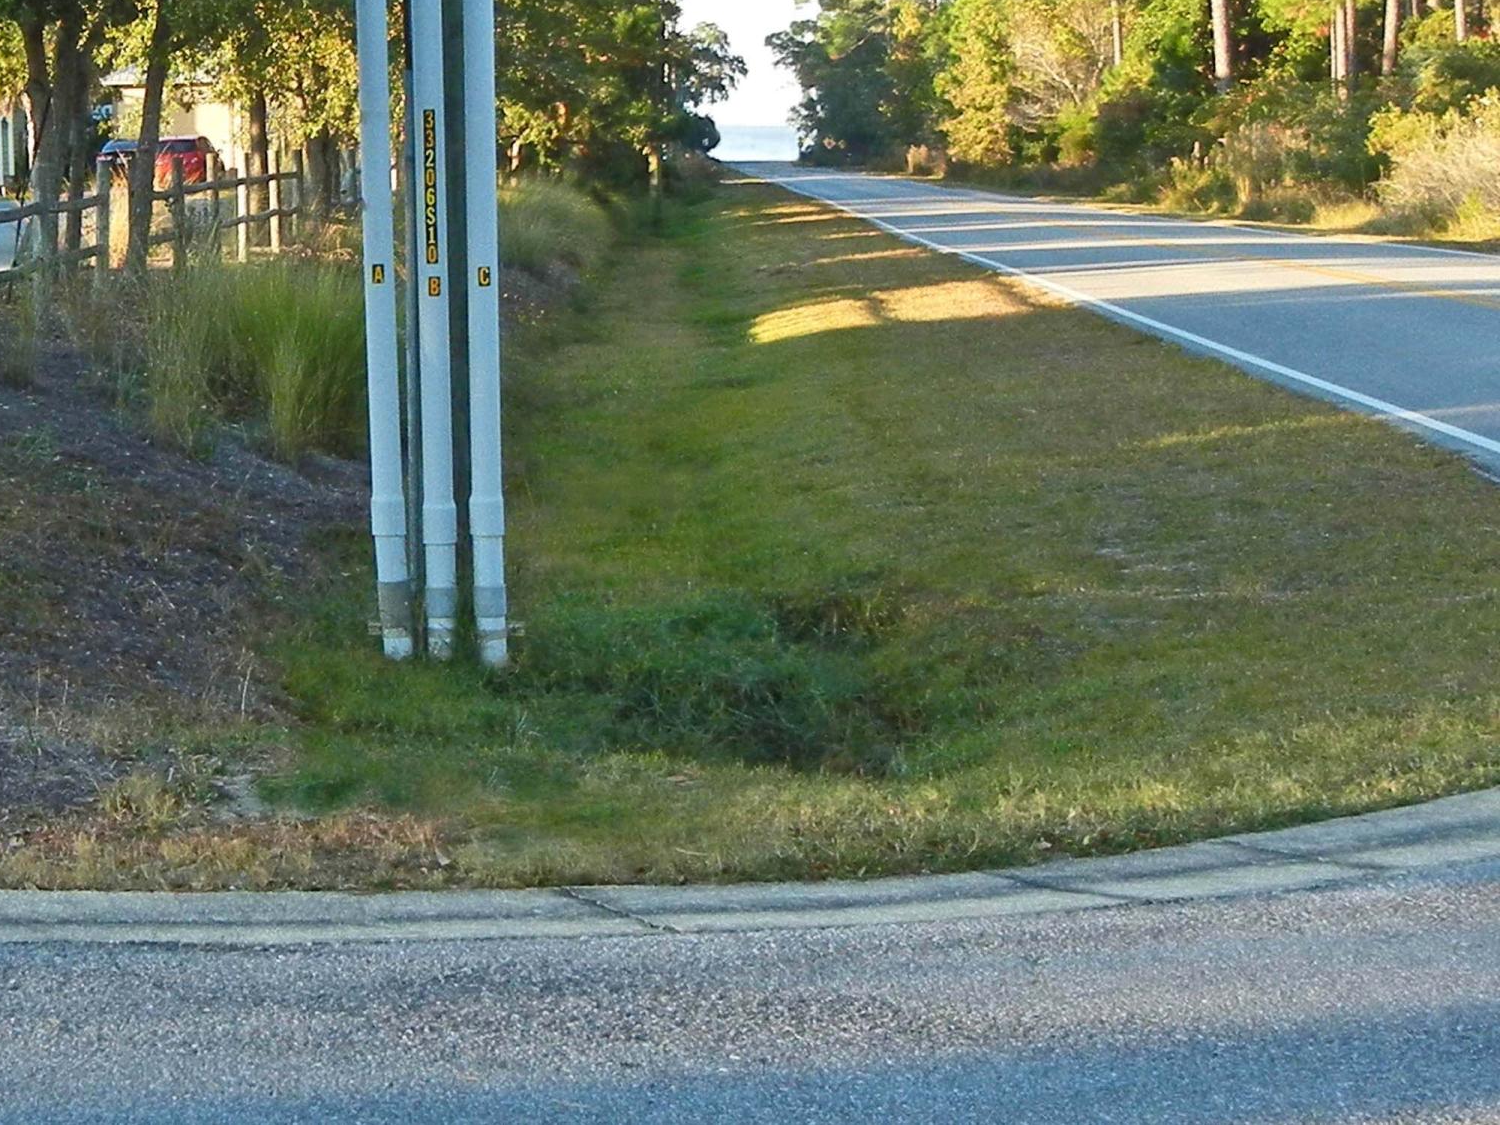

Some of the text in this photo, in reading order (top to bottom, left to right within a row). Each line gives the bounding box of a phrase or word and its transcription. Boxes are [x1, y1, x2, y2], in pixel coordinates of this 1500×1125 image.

[374, 266, 384, 283] A
[479, 268, 490, 285] C
[429, 278, 440, 295] B
